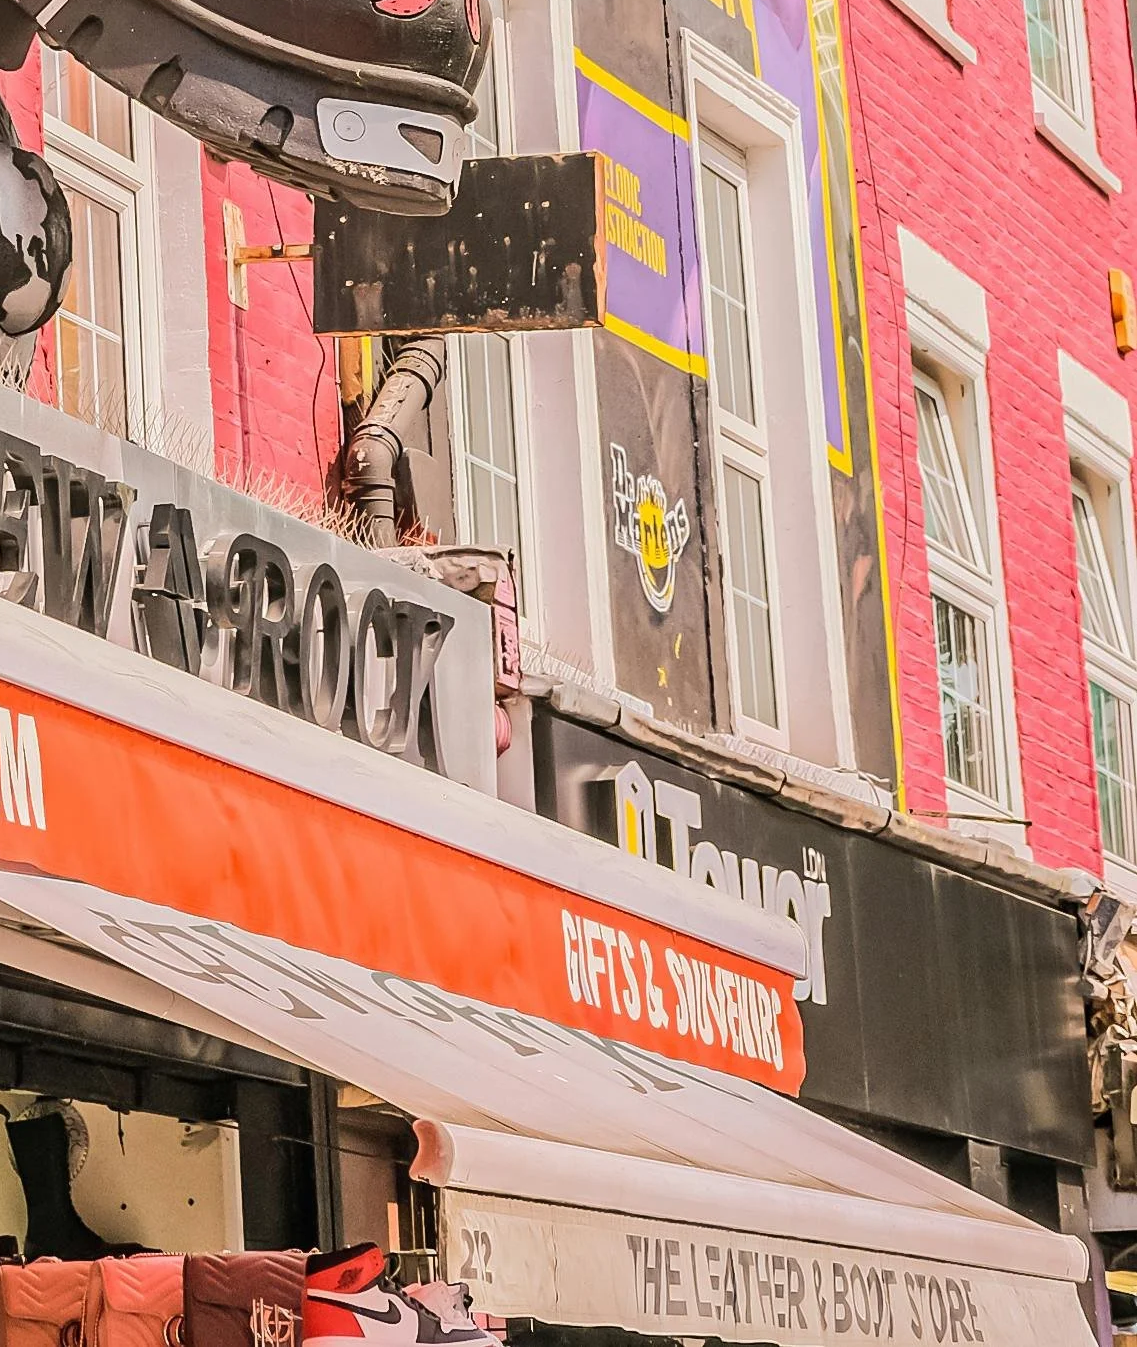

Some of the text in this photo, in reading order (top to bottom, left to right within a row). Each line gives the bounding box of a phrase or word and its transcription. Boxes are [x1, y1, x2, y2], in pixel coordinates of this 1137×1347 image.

[207, 533, 455, 777] ROCK
[562, 908, 784, 1072] GIFTS & SOUVENIRS
[626, 1234, 985, 1344] THE LEATHER & BOOT STORE
